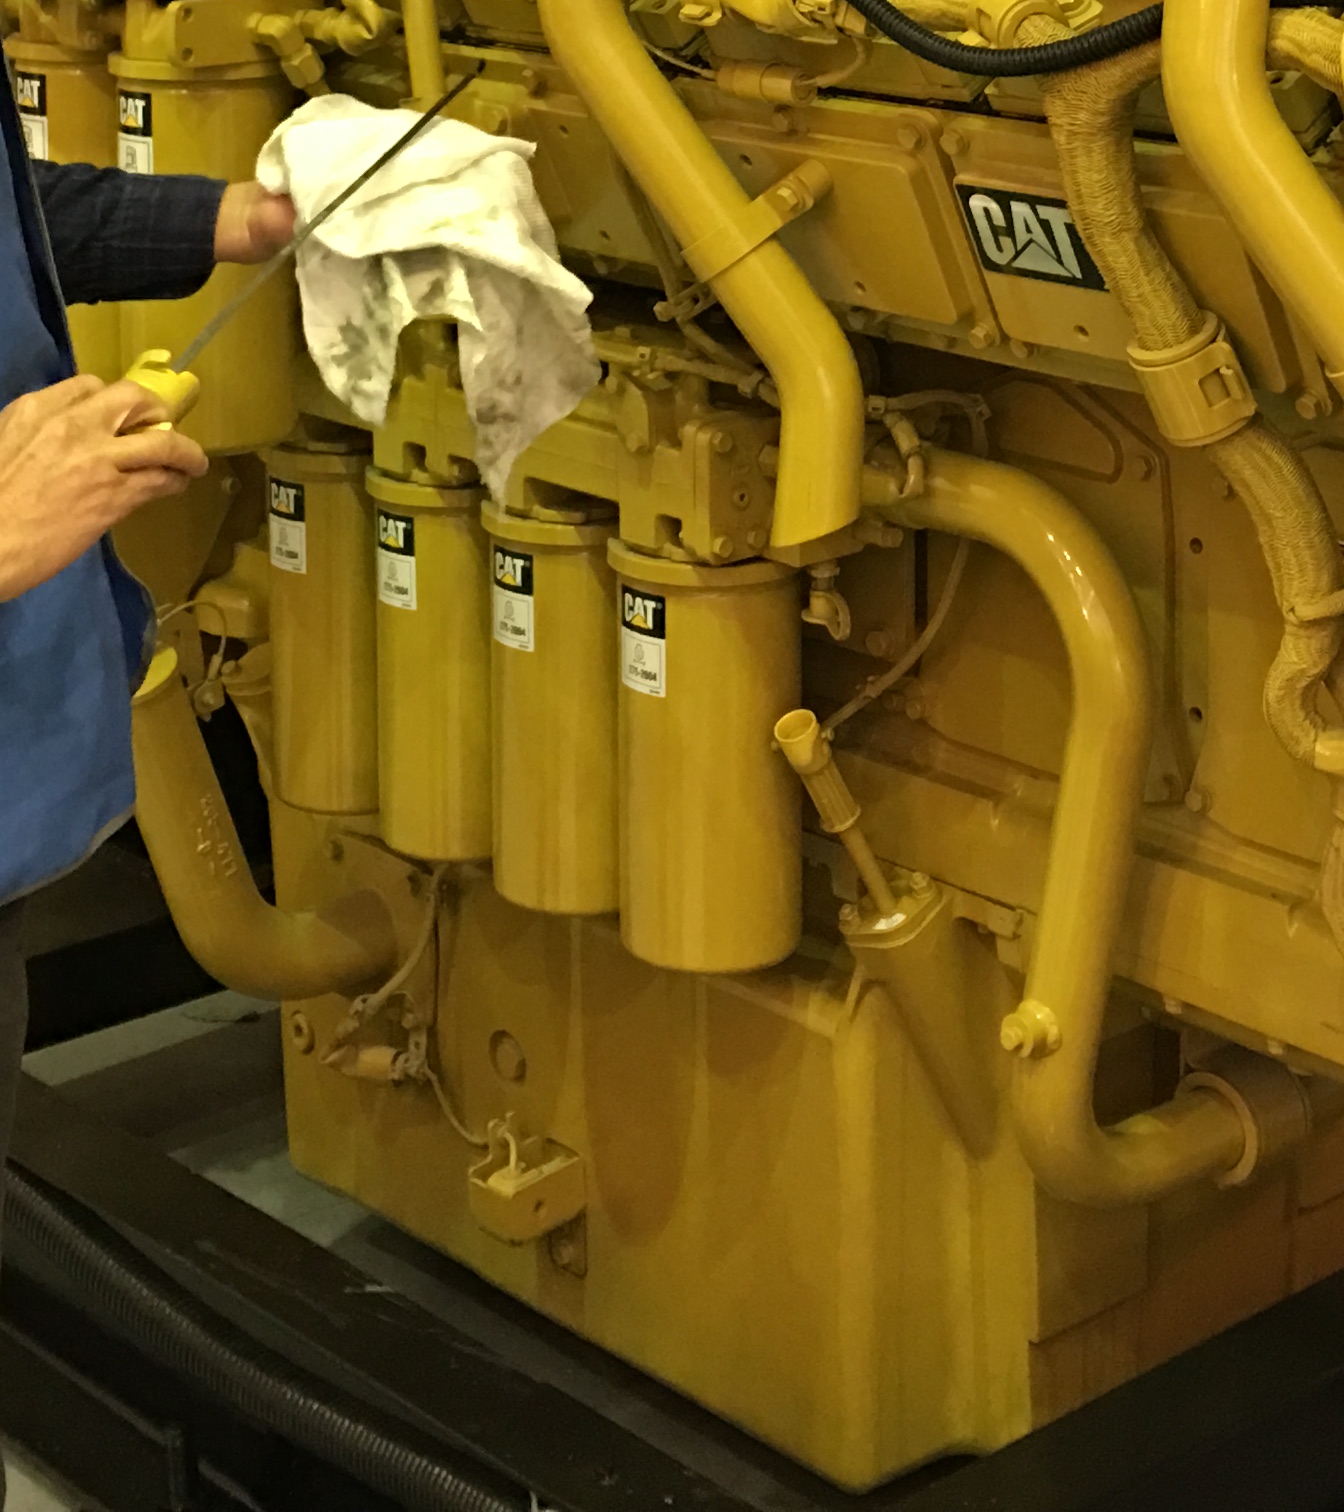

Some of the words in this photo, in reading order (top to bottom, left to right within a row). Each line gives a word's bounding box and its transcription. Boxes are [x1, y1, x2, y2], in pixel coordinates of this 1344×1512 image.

[17, 76, 41, 108] CAT
[119, 95, 146, 128] CAT
[968, 193, 1083, 279] CAT
[270, 482, 297, 514] CAT
[378, 514, 407, 548] CAT
[495, 551, 525, 587] CAT
[624, 592, 657, 630] CAT
